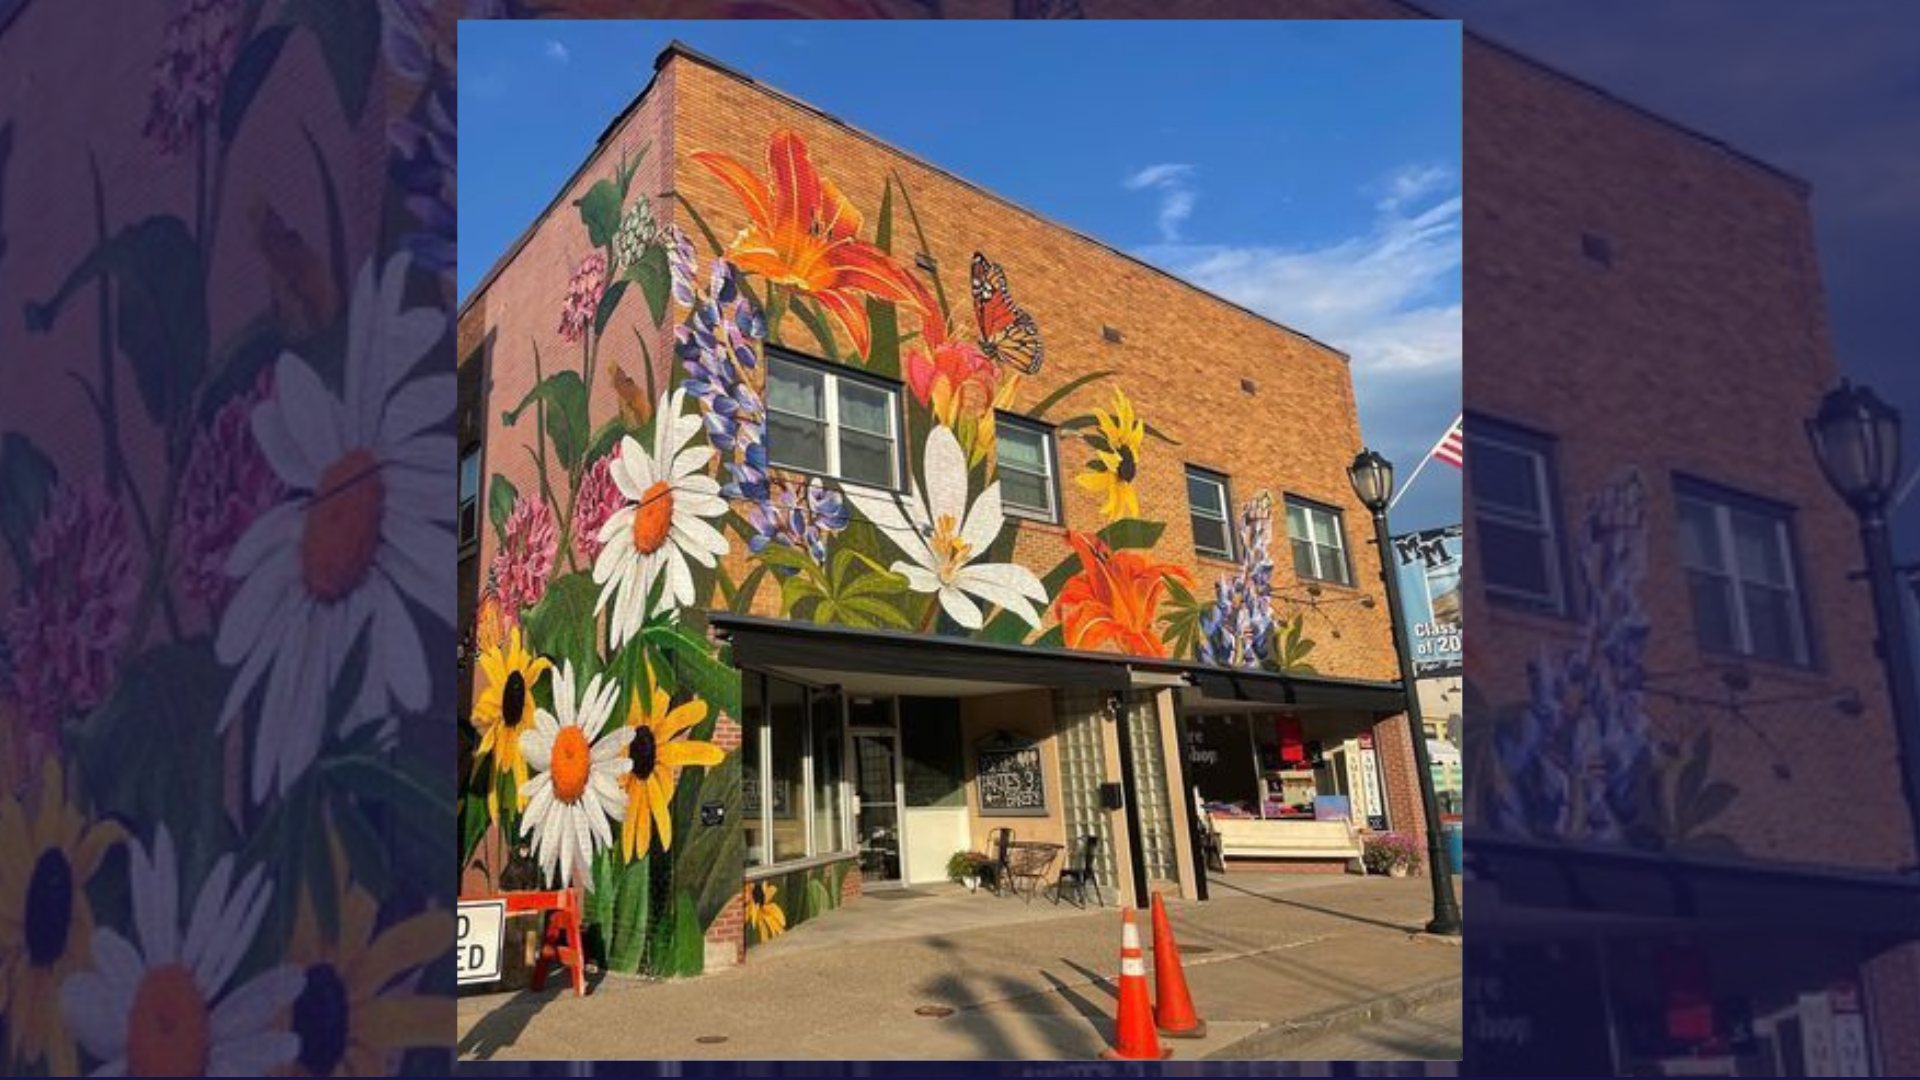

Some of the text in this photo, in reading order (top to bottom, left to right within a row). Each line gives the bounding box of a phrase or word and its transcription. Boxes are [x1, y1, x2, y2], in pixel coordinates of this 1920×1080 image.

[1414, 621, 1457, 636] Class
[1418, 635, 1461, 654] of 20
